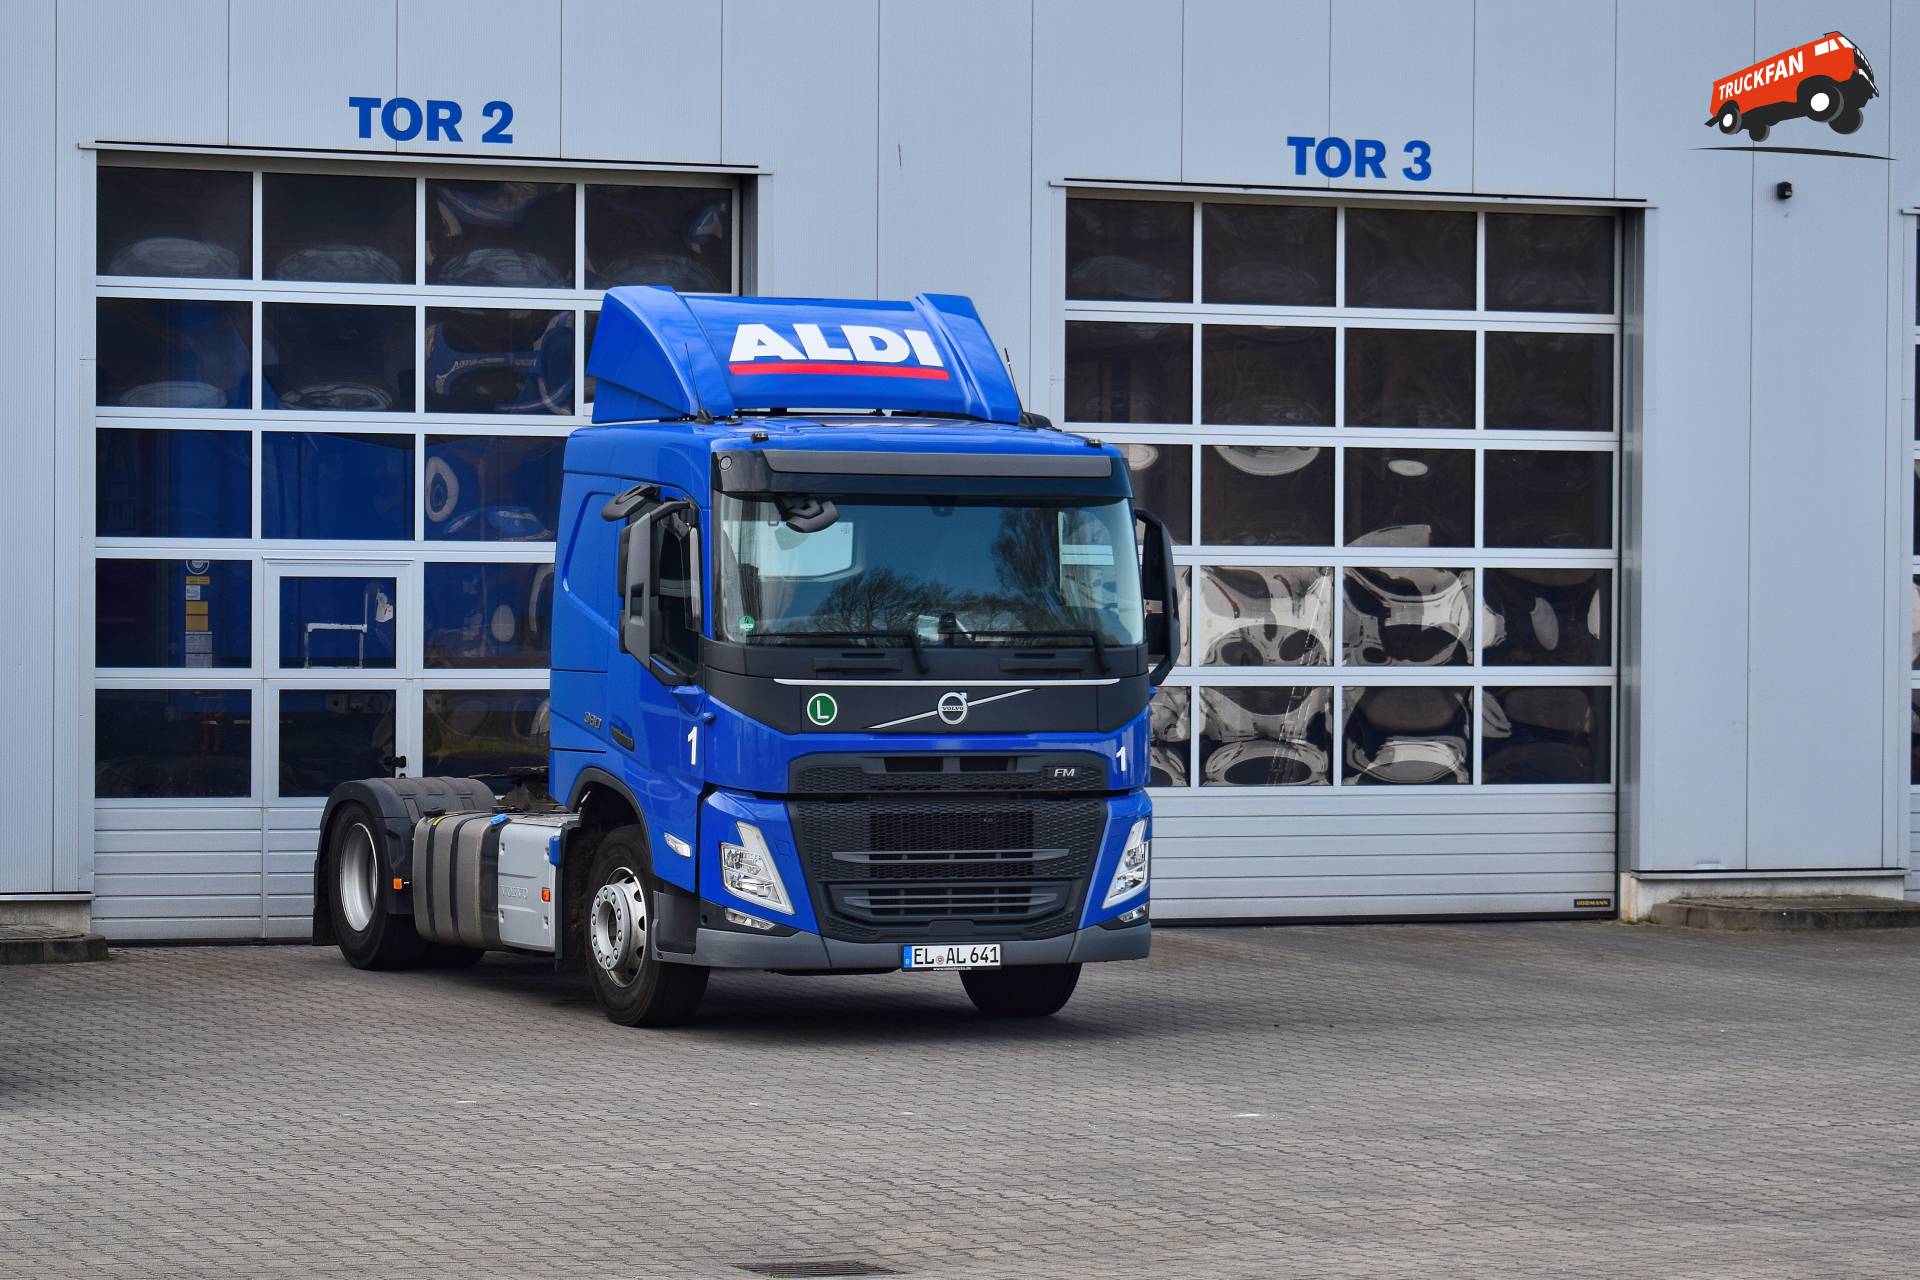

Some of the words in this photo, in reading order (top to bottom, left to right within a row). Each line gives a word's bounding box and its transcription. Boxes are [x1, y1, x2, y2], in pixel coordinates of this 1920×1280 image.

[348, 96, 463, 142] TOR
[482, 100, 513, 143] 2
[1287, 136, 1387, 178] TOR
[1402, 140, 1431, 181] 3
[729, 324, 944, 367] ALDI
[815, 700, 829, 719] L
[687, 726, 698, 765] 1
[1115, 746, 1126, 771] 1
[1054, 768, 1075, 777] FM
[914, 948, 935, 965] EL
[946, 947, 966, 964] AL
[970, 946, 999, 964] 641
